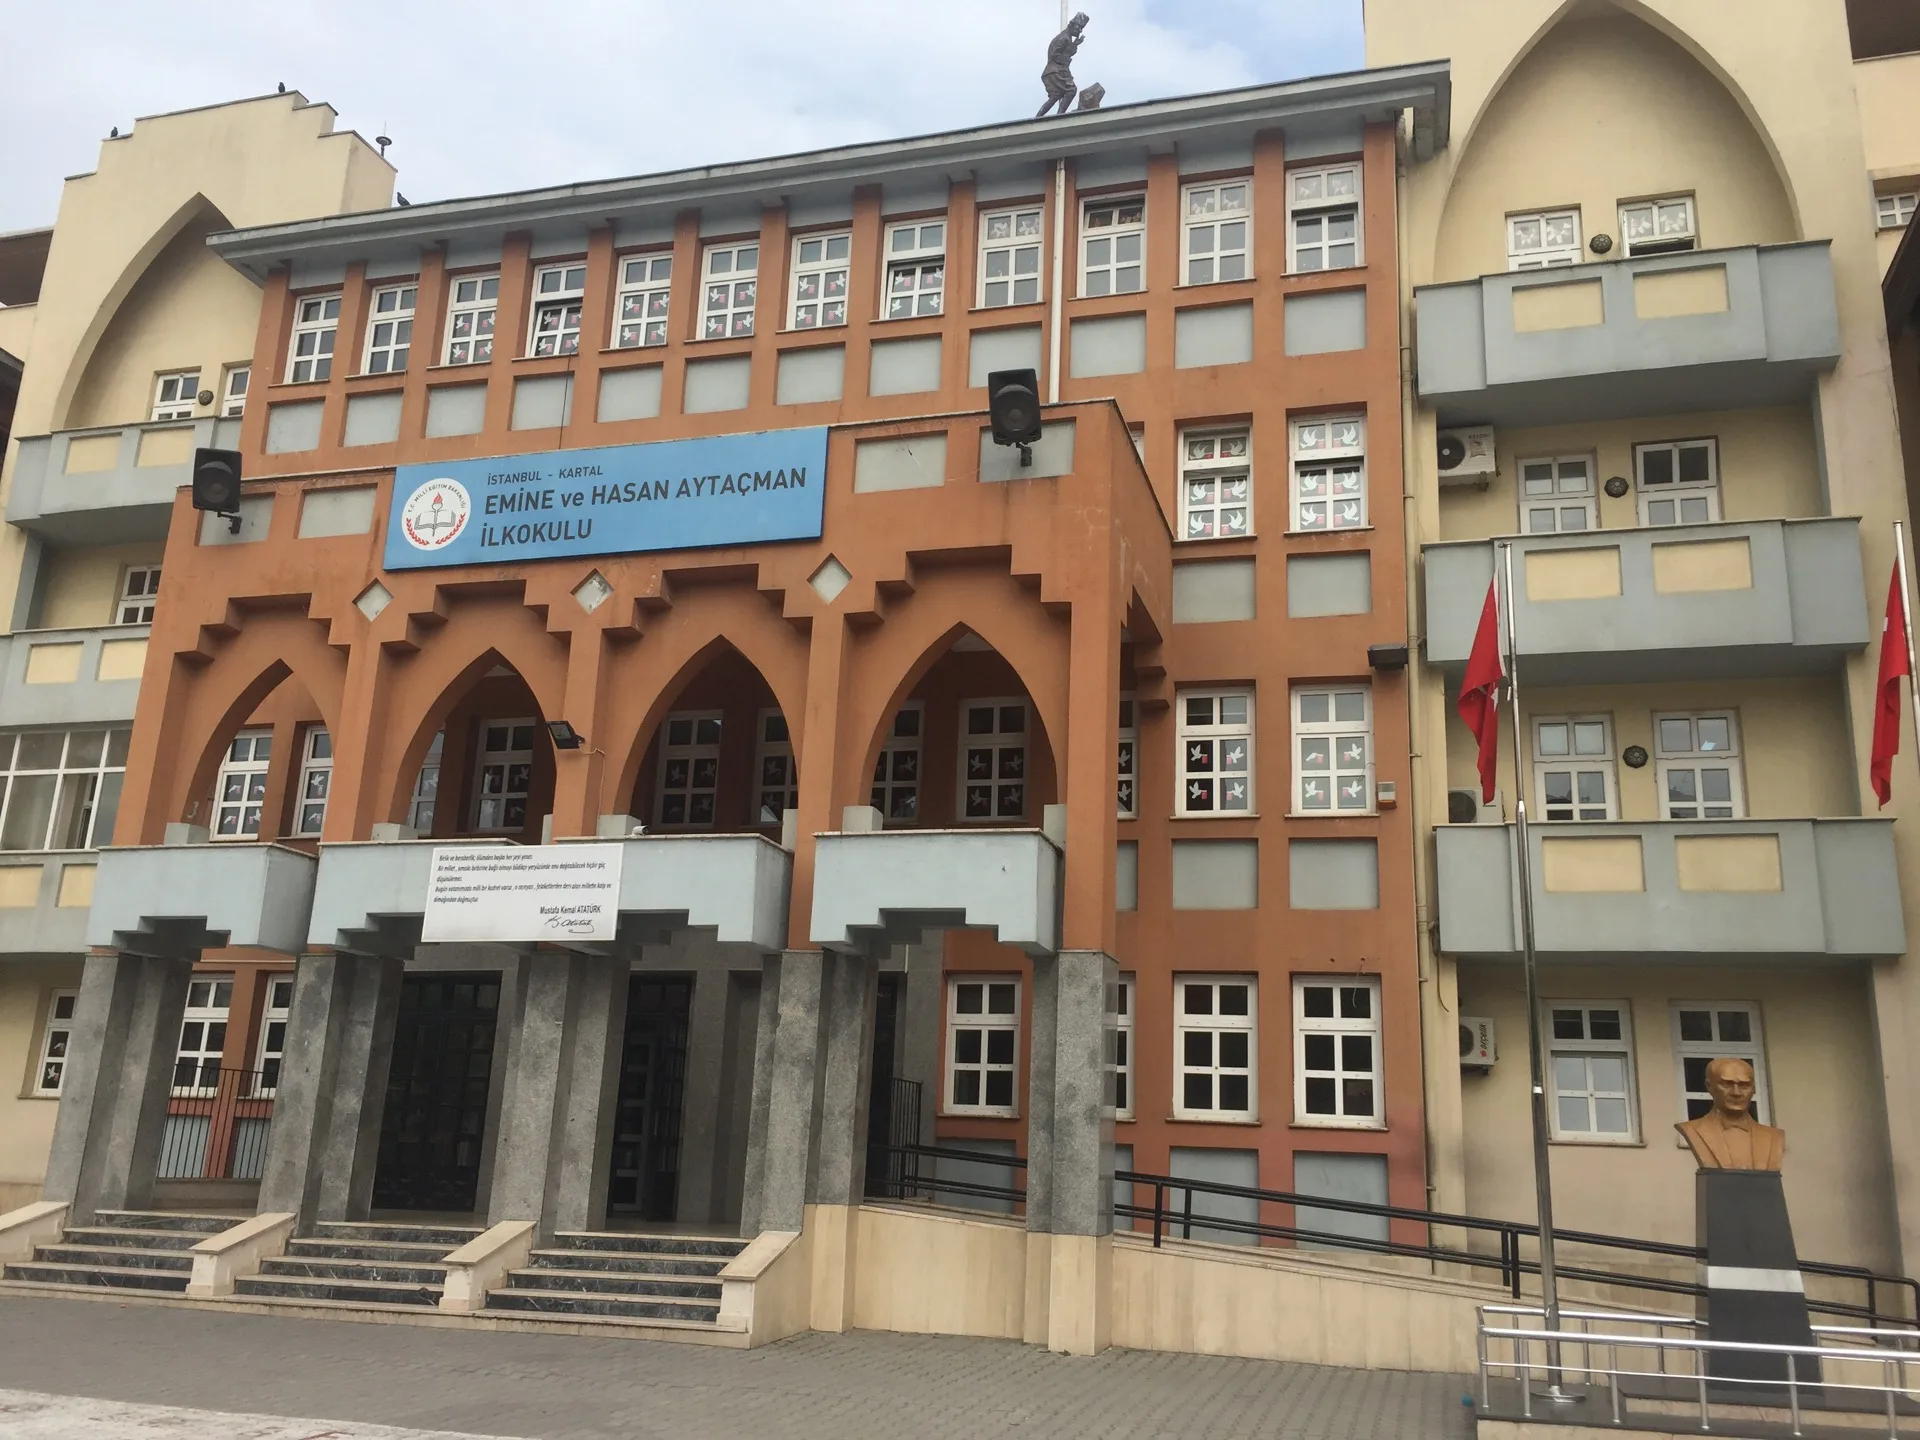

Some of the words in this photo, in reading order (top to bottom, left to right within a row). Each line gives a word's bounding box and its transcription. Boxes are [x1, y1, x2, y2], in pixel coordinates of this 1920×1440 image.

[487, 471, 542, 485] İSTANBUL
[559, 465, 603, 479] KARTAL
[485, 488, 555, 515] EMİNE
[561, 491, 584, 507] ve
[591, 479, 669, 506] HASAN
[675, 467, 806, 498] AYTAÇMAN
[481, 518, 592, 547] İLKOKULU
[540, 905, 559, 914] Mustafa
[560, 905, 576, 914] Kemal
[576, 903, 601, 913] ATATÜRK
